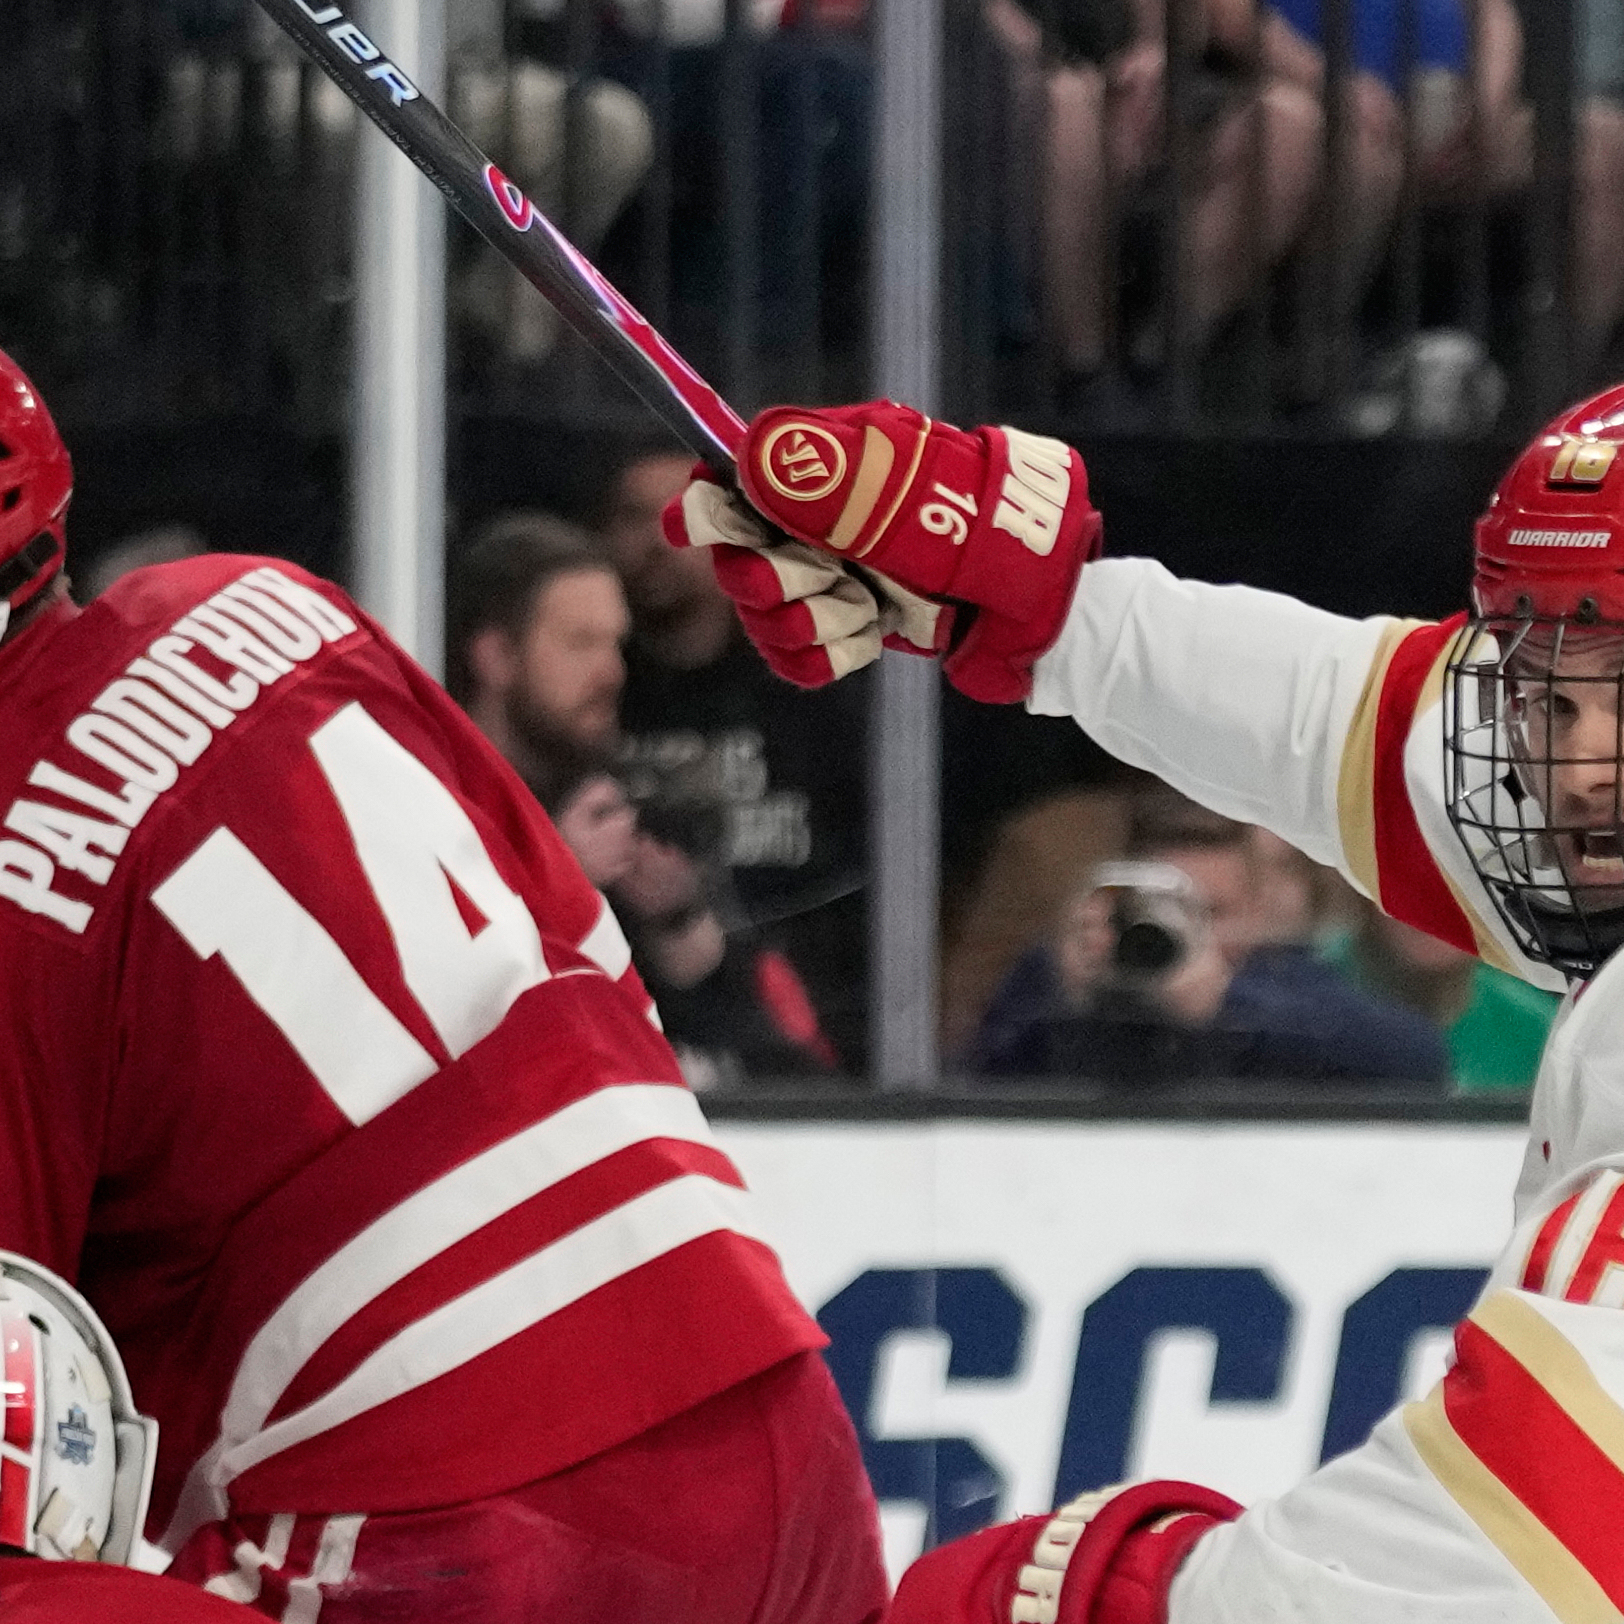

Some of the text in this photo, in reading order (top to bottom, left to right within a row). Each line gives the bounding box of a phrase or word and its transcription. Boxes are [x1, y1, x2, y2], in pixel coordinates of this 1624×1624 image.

[1549, 436, 1618, 482] 16
[919, 482, 979, 546] 16
[1507, 529, 1612, 549] WARRIOR
[149, 701, 554, 1128] 14
